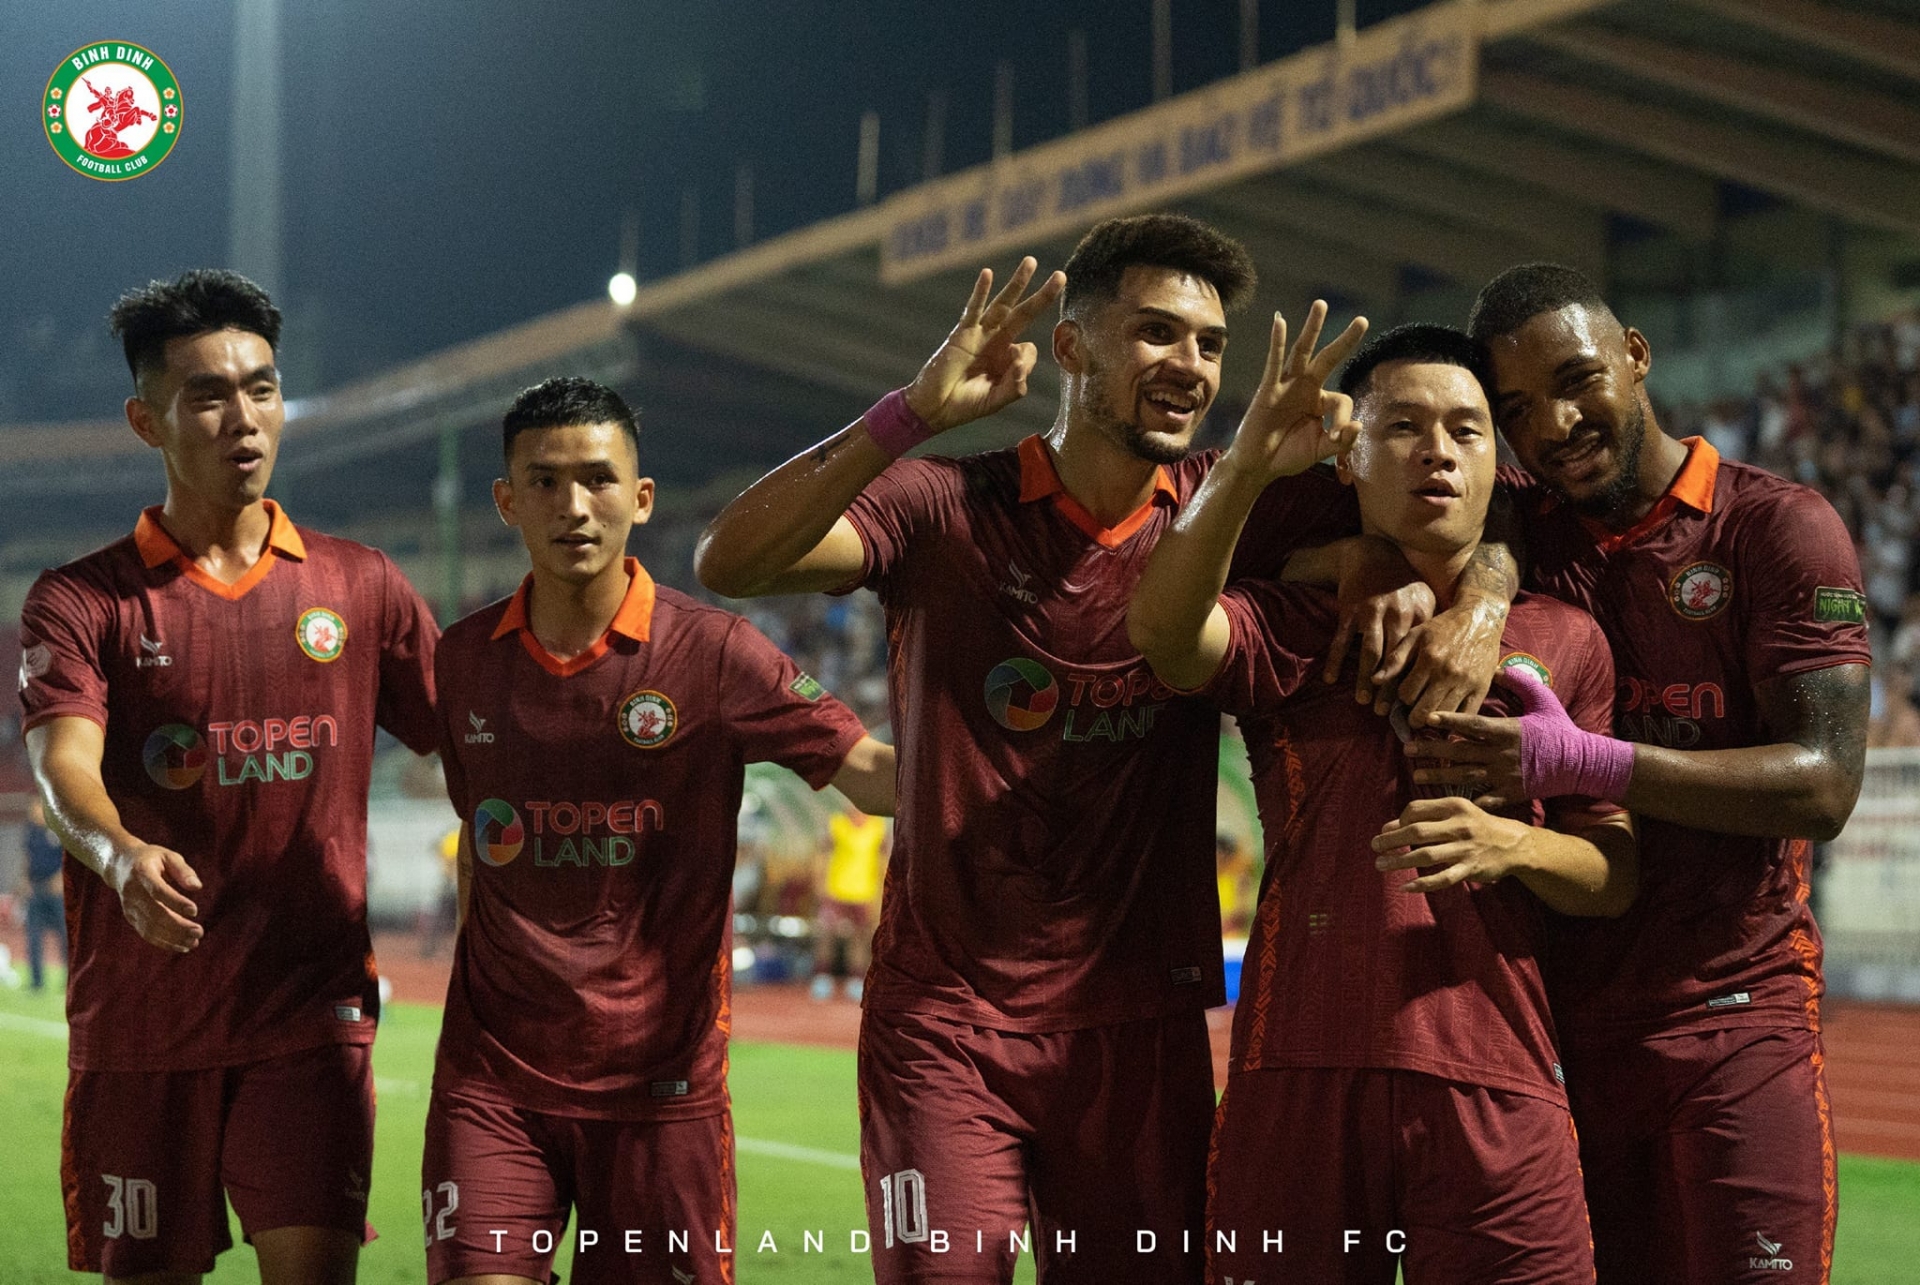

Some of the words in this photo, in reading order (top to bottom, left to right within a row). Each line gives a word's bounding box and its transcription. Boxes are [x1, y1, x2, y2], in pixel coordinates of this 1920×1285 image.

[1819, 598, 1852, 615] NIGHT
[1618, 675, 1725, 719] OPEN
[208, 715, 338, 754] TOPEN
[464, 732, 495, 744] KAMITO
[1619, 714, 1701, 747] AND
[218, 751, 314, 786] LAND
[525, 799, 664, 835] TOPEN
[534, 836, 635, 868] LAND
[101, 1174, 158, 1239] 30
[880, 1168, 929, 1249] 10
[1749, 1257, 1793, 1271] KAMITO
